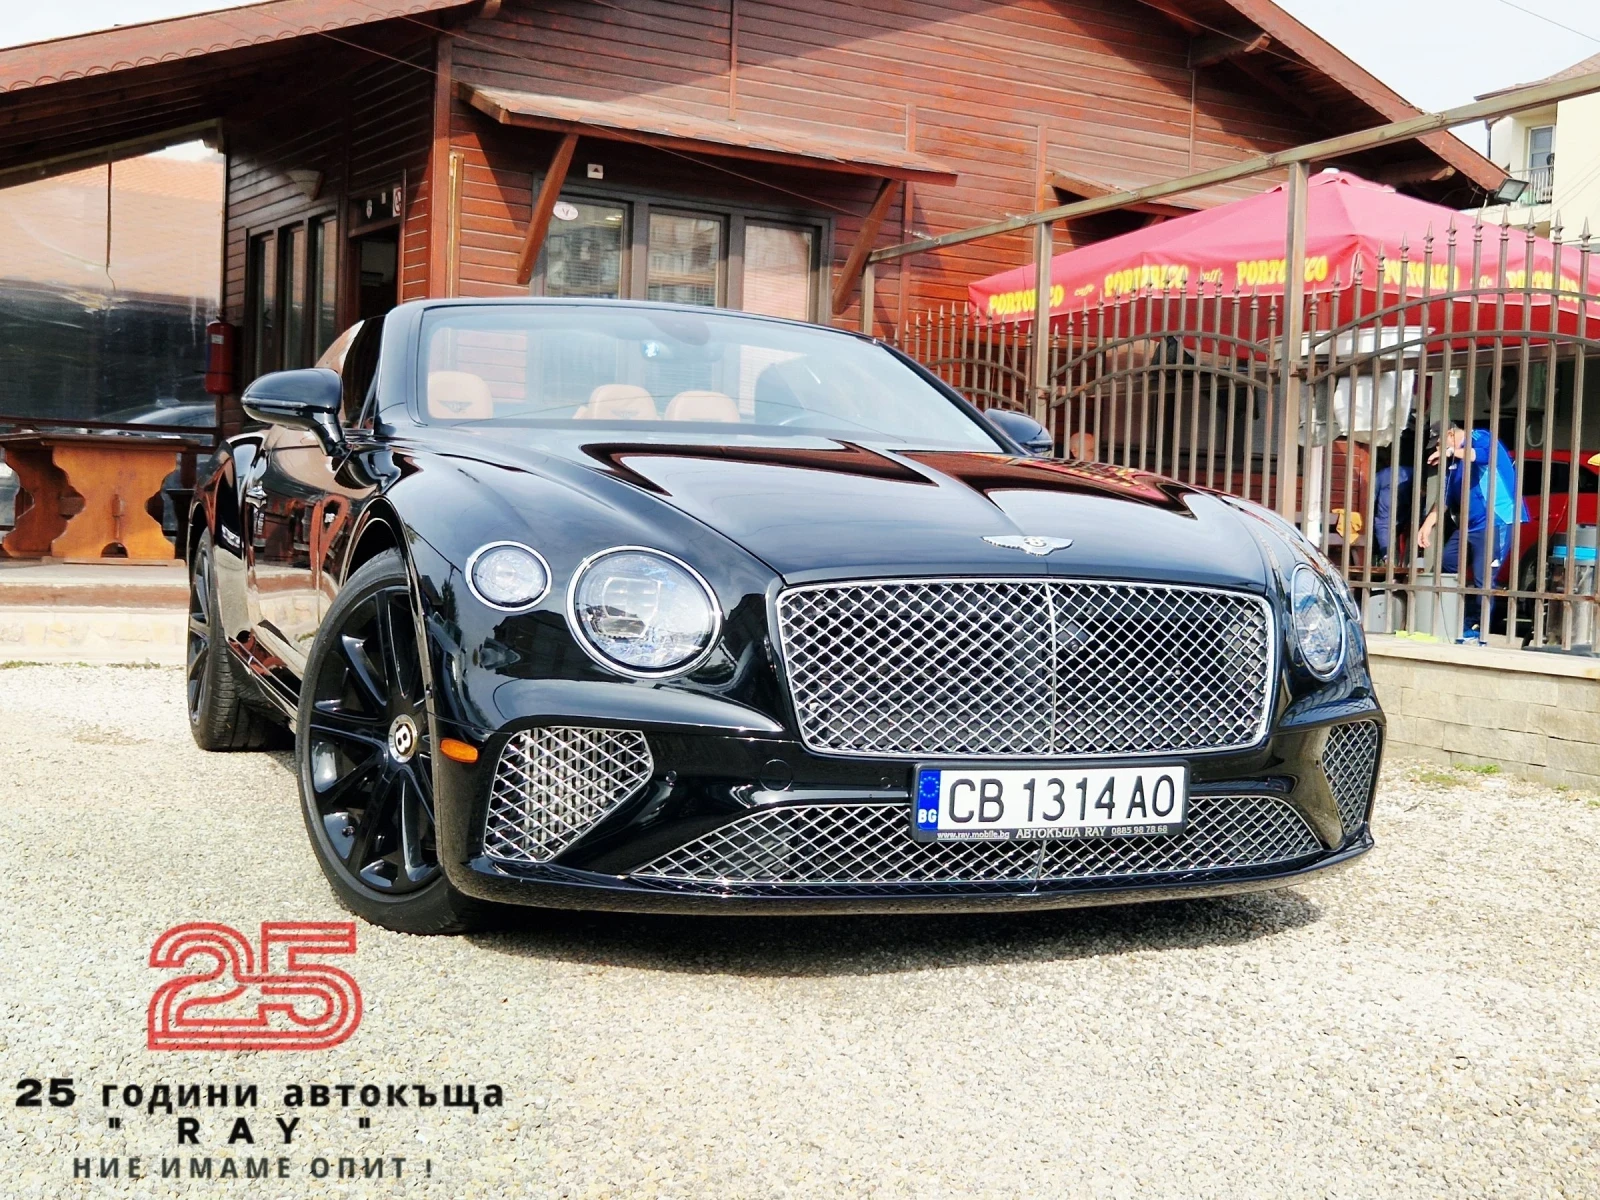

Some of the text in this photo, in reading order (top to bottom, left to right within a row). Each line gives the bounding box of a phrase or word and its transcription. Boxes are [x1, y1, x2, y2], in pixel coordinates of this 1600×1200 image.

[1236, 255, 1328, 286] PORTOCO
[948, 778, 1004, 823] CB
[1023, 776, 1115, 822] 1314
[918, 808, 938, 823] BG
[937, 830, 1010, 840] www.ray.mobile.bg
[1084, 826, 1106, 837] RAY
[1111, 826, 1132, 836] 0885
[1134, 825, 1144, 834] 98
[1146, 825, 1156, 834] 78
